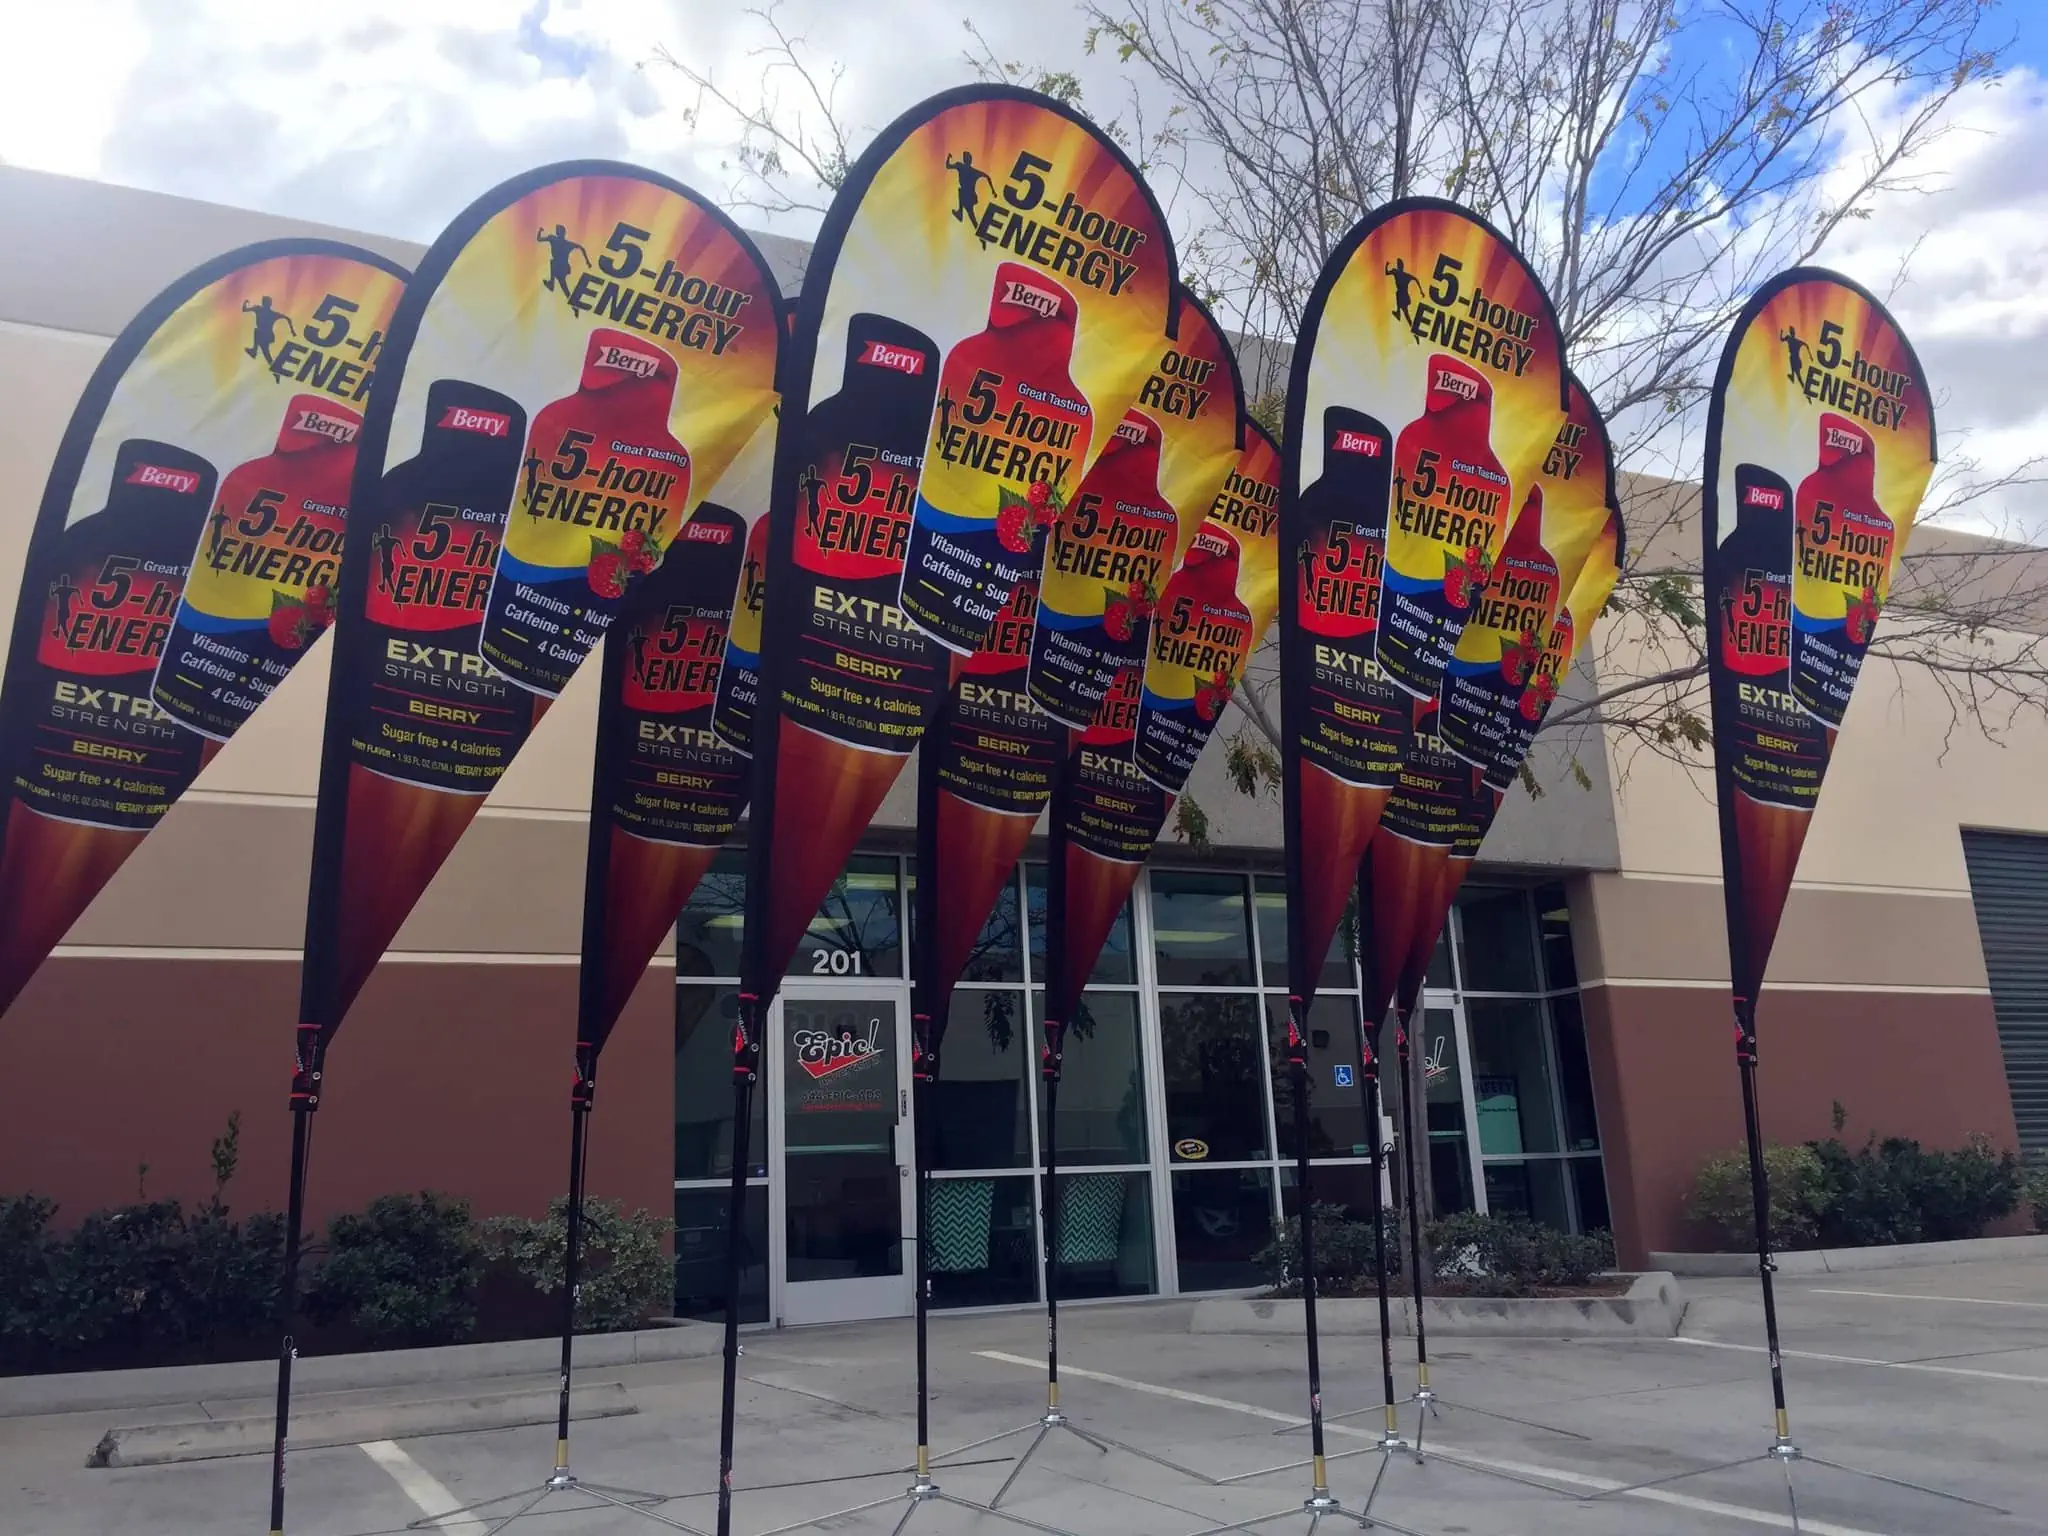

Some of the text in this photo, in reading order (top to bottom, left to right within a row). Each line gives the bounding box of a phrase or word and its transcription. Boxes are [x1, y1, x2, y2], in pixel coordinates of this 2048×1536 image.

[1002, 150, 1148, 258] 5-hour
[975, 202, 1139, 298] ENERGY
[598, 221, 752, 319] 5-hour
[1011, 283, 1057, 317] Berry
[1429, 253, 1539, 342] 5-hour
[567, 272, 745, 356] ENERGY
[1411, 302, 1536, 377] ENERGY
[605, 347, 655, 378] Berry
[872, 344, 919, 375] Berry
[1816, 319, 1912, 398] 5-hour
[1017, 382, 1089, 416] Great Tasting
[1441, 371, 1477, 400] Berry
[1802, 365, 1908, 432] ENERGY
[452, 408, 505, 437] Berry
[961, 367, 1079, 451] 5-hour
[303, 411, 355, 444] Berry
[1828, 429, 1861, 454] Berry
[611, 440, 688, 467] Great Tasting
[881, 449, 911, 468] Great
[940, 424, 1072, 487] ENERGY
[1342, 432, 1378, 457] Berry
[550, 427, 678, 501] 5-hour
[1452, 459, 1507, 485] Great Tasting
[141, 465, 194, 493] Berry
[1412, 447, 1502, 517] 5-hour
[303, 500, 337, 517] Great
[527, 481, 668, 535] ENERGY
[1115, 500, 1176, 522] Great Tasting
[1751, 487, 1781, 510] Berry
[461, 507, 495, 523] Great
[1071, 491, 1168, 553] 5-hour
[1400, 499, 1497, 550] ENERGY
[1811, 499, 1889, 559] 5-hour
[687, 523, 729, 545] Berry
[1197, 533, 1228, 558] Berry
[1355, 524, 1379, 539] Great
[930, 531, 982, 570] Vitamins
[1055, 540, 1162, 584] ENERGY
[143, 560, 177, 577] Great
[921, 553, 973, 589] Caffeine
[984, 582, 1010, 606] Sug
[1505, 556, 1557, 577] Great Tasting
[1802, 546, 1885, 589] ENERGY
[515, 583, 571, 617] Vitamins
[696, 607, 722, 620] Great
[952, 594, 962, 608] 4
[1395, 593, 1434, 625] Vitamins
[505, 602, 560, 636] Caffeine
[812, 612, 924, 653] STRENGTH
[1168, 594, 1244, 650] 5-hour
[1390, 612, 1428, 642] Caffeine
[192, 632, 249, 665] Vitamins
[538, 640, 548, 654] 4
[1049, 630, 1093, 658] Vitamins
[1157, 634, 1241, 674] ENERGY
[1414, 647, 1422, 660] 4
[1804, 633, 1839, 660] Vitamins
[181, 650, 236, 683] Caffeine
[835, 652, 902, 681] BERRY
[1043, 648, 1085, 676] Caffeine
[1094, 668, 1115, 687] Sug
[1800, 650, 1834, 676] Caffeine
[211, 687, 222, 700] 4
[384, 663, 505, 697] STRENGTH
[1068, 680, 1076, 692] 4
[1315, 667, 1395, 700] STRENGTH
[1455, 676, 1493, 701] Vitamins
[1822, 681, 1829, 692] 4
[810, 676, 841, 698] Sugar
[844, 687, 862, 704] free
[874, 696, 880, 709] 4
[883, 698, 921, 717] calories
[1450, 692, 1487, 717] Caffeine
[51, 705, 176, 739] STRENGTH
[409, 699, 481, 725] BERRY
[958, 704, 1048, 732] STRENGTH
[1151, 709, 1187, 734] Vitamins
[1333, 702, 1381, 725] BERRY
[1739, 703, 1811, 729] STRENGTH
[382, 722, 502, 758] Sugar free 4 calories
[1146, 724, 1180, 749] Caffeine
[1320, 722, 1341, 742] Sugar
[1362, 738, 1368, 749] 4
[1370, 741, 1398, 754] calories
[1472, 721, 1480, 733] 4
[72, 740, 148, 764] BERRY
[638, 741, 733, 765] STRENGTH
[977, 735, 1031, 755] BERRY
[1165, 751, 1173, 762] 4
[1756, 733, 1800, 753] BERRY
[42, 763, 77, 785] Sugar
[79, 770, 102, 787] free
[113, 777, 121, 790] 4
[123, 780, 166, 796] calories
[656, 771, 713, 789] BERRY
[960, 755, 1047, 784] Sugar free 4 calories
[1079, 766, 1151, 794] STRENGTH
[1399, 773, 1442, 791] BERRY
[635, 793, 661, 810] Sugar
[663, 796, 680, 811] free
[690, 802, 696, 813] 4
[1095, 793, 1137, 813] BERRY
[812, 948, 862, 975] 201
[793, 1017, 880, 1068] Epic!
